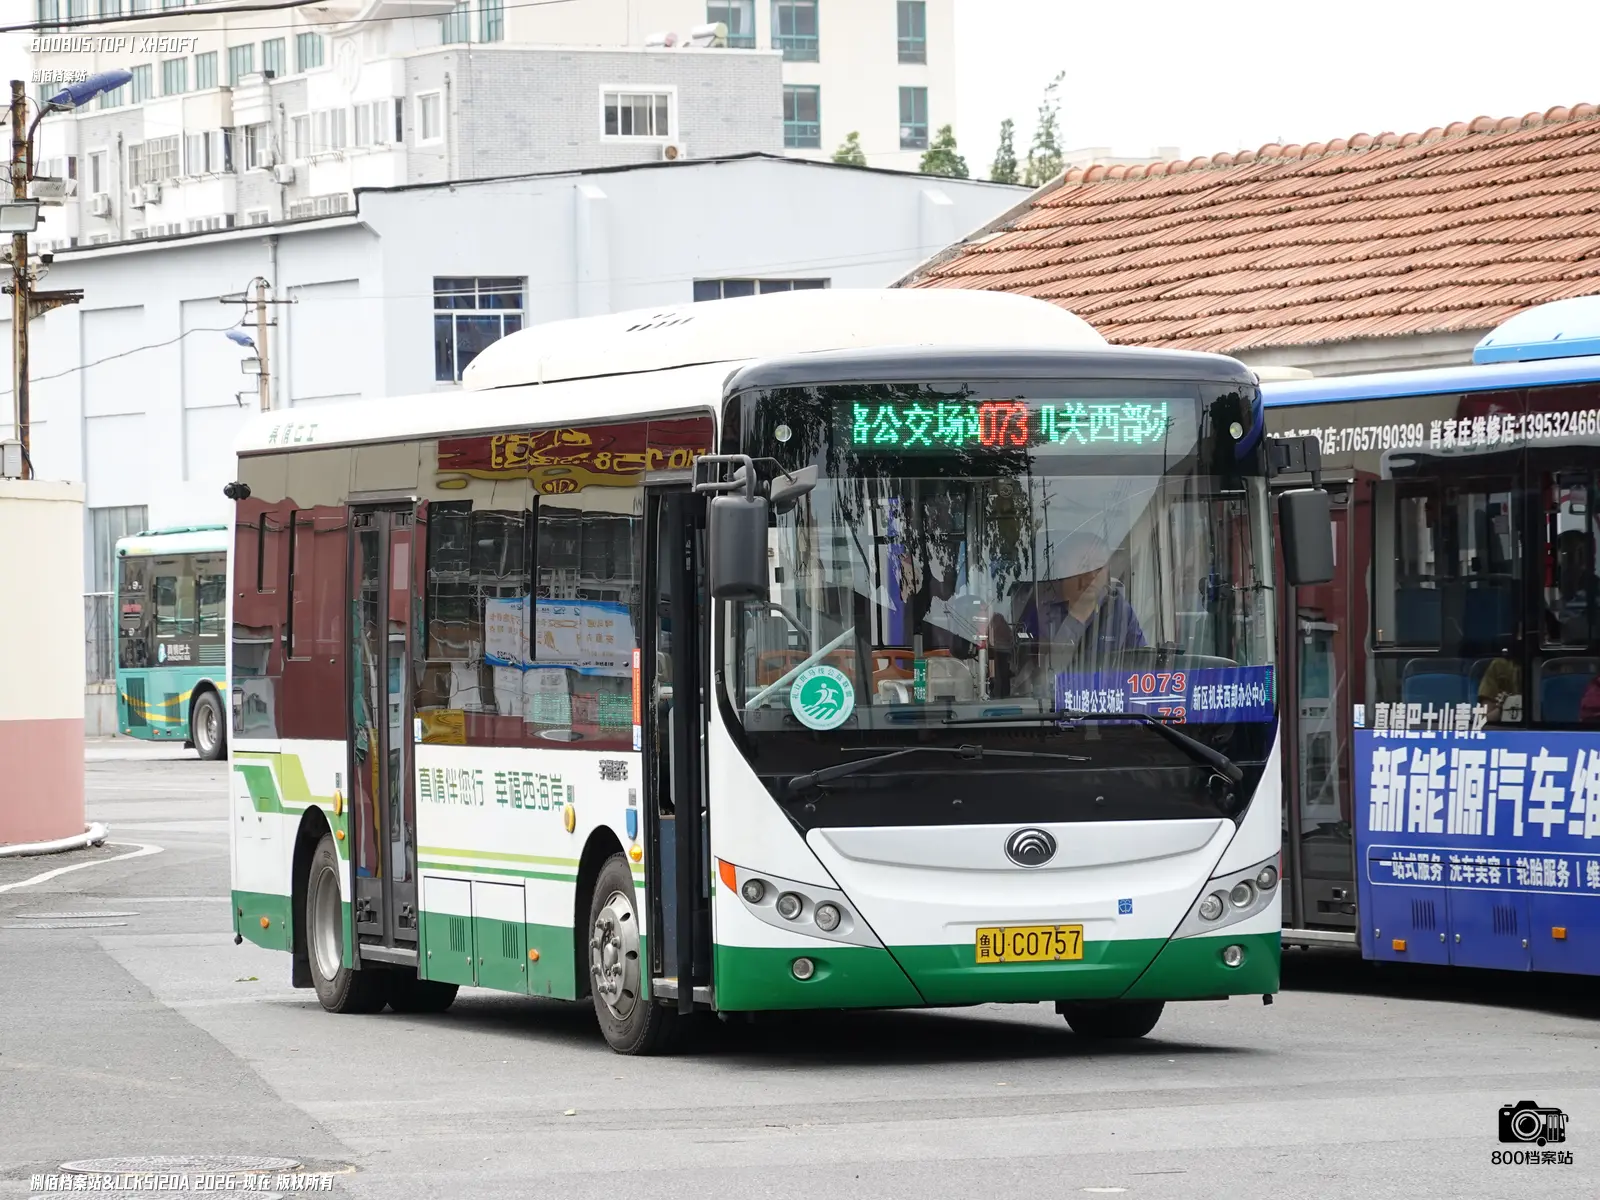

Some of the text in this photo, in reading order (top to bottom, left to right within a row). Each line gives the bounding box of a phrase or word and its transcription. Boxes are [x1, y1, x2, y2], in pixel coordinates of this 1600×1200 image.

[980, 401, 1028, 446] 073
[1284, 423, 1424, 455] 店:17657190399
[1127, 672, 1186, 693] 1073
[1193, 682, 1266, 711] 新区机关西部办公中心
[1373, 702, 1488, 739] 真情巴士小青龙
[419, 767, 484, 806] 真情伴您行
[495, 770, 564, 812] 幸福西海岸
[1369, 746, 1600, 839] 新能源汽车维
[1379, 852, 1443, 881] 一站式服务
[1449, 855, 1501, 884] 洗车美容
[1516, 857, 1570, 887] 轮胎服务
